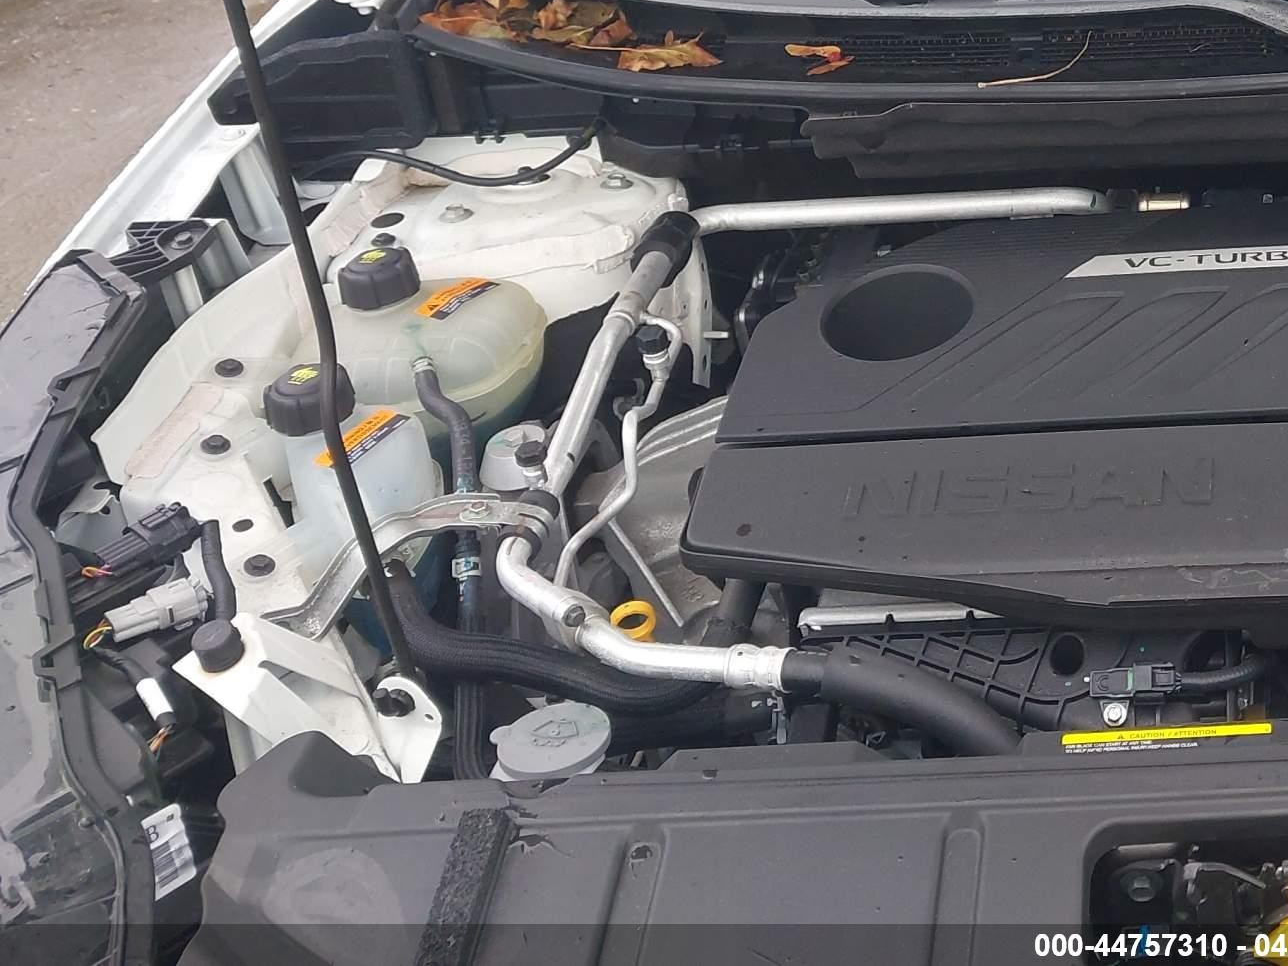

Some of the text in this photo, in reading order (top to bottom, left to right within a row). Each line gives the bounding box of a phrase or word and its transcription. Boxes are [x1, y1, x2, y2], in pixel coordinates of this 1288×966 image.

[840, 457, 1215, 520] NISSAN
[1129, 732, 1165, 740] CAUTION
[1173, 729, 1217, 738] ATTENTION
